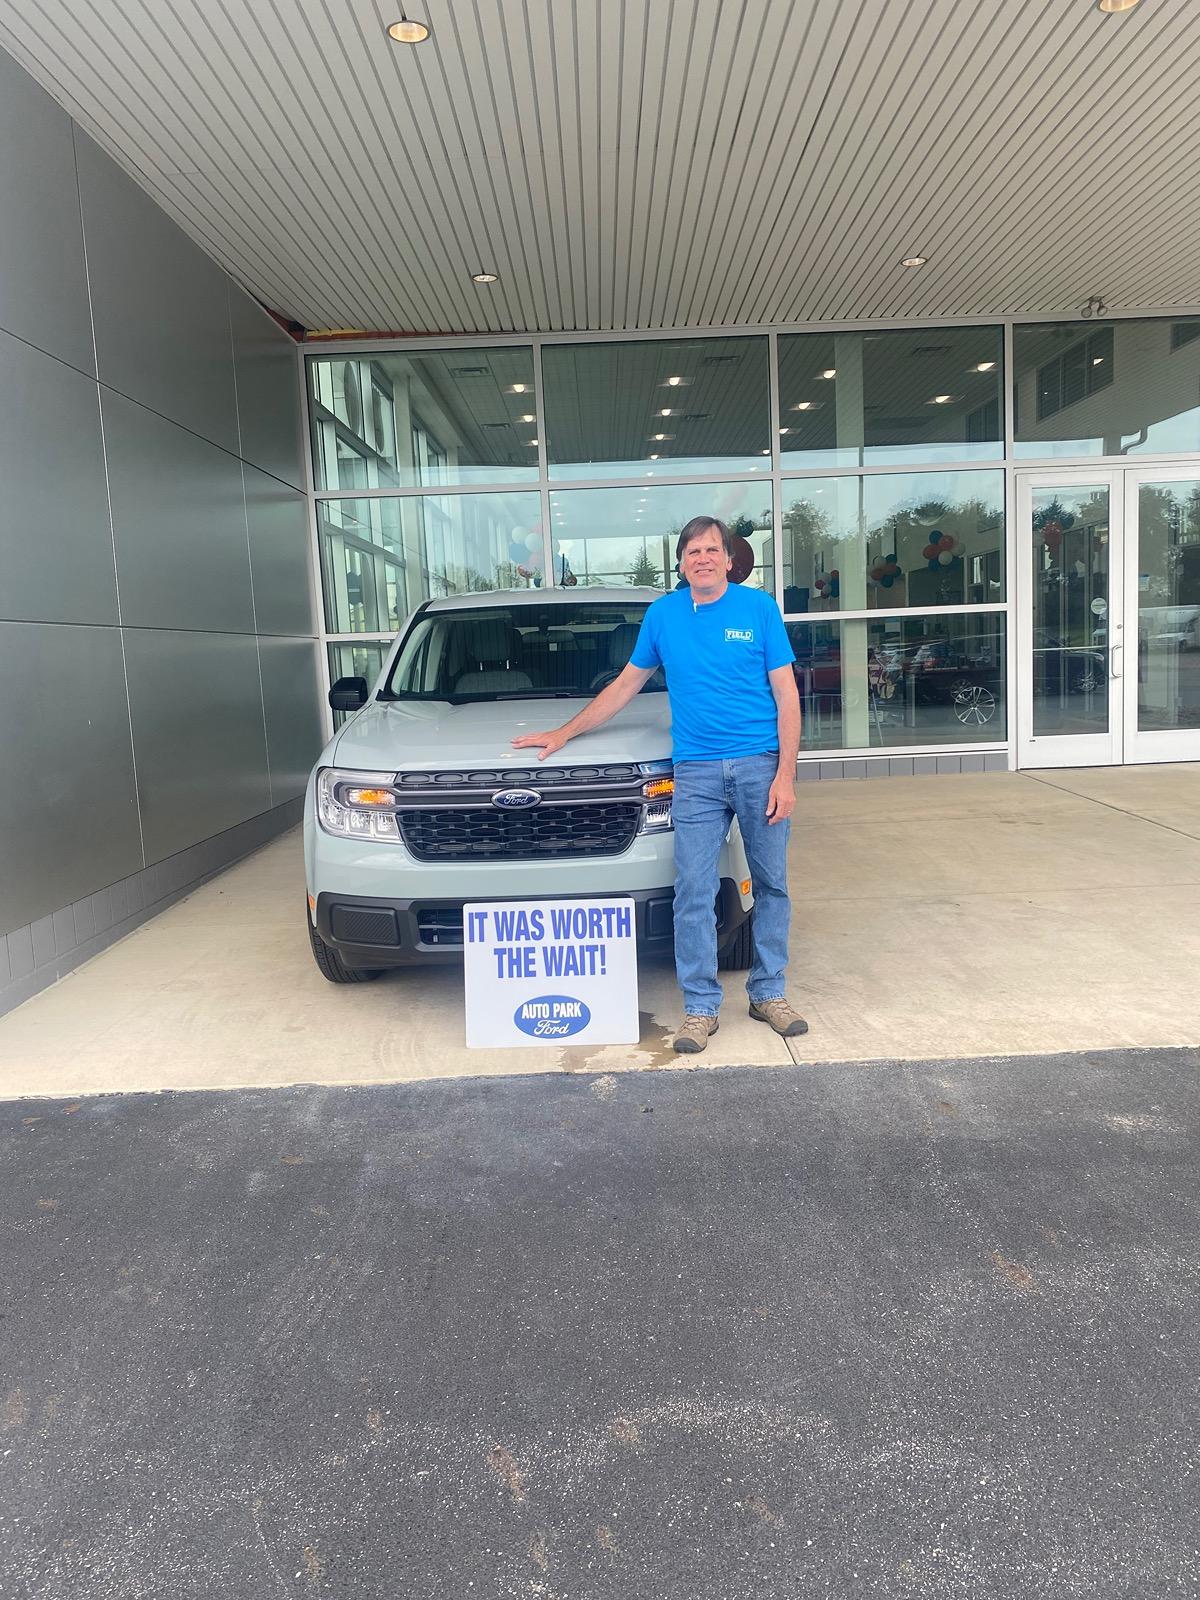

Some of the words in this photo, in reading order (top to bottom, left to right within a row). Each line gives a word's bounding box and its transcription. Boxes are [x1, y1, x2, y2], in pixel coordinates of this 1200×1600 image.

[727, 630, 752, 640] FIELD
[503, 793, 529, 805] Ford
[468, 912, 488, 942] IT
[494, 909, 545, 942] WAS
[551, 907, 631, 940] WORTH
[493, 947, 537, 978] THE
[542, 944, 606, 977] WAIT!
[521, 1003, 550, 1019] AUTO
[553, 1002, 582, 1018] PARK
[533, 1020, 569, 1035] Ford
